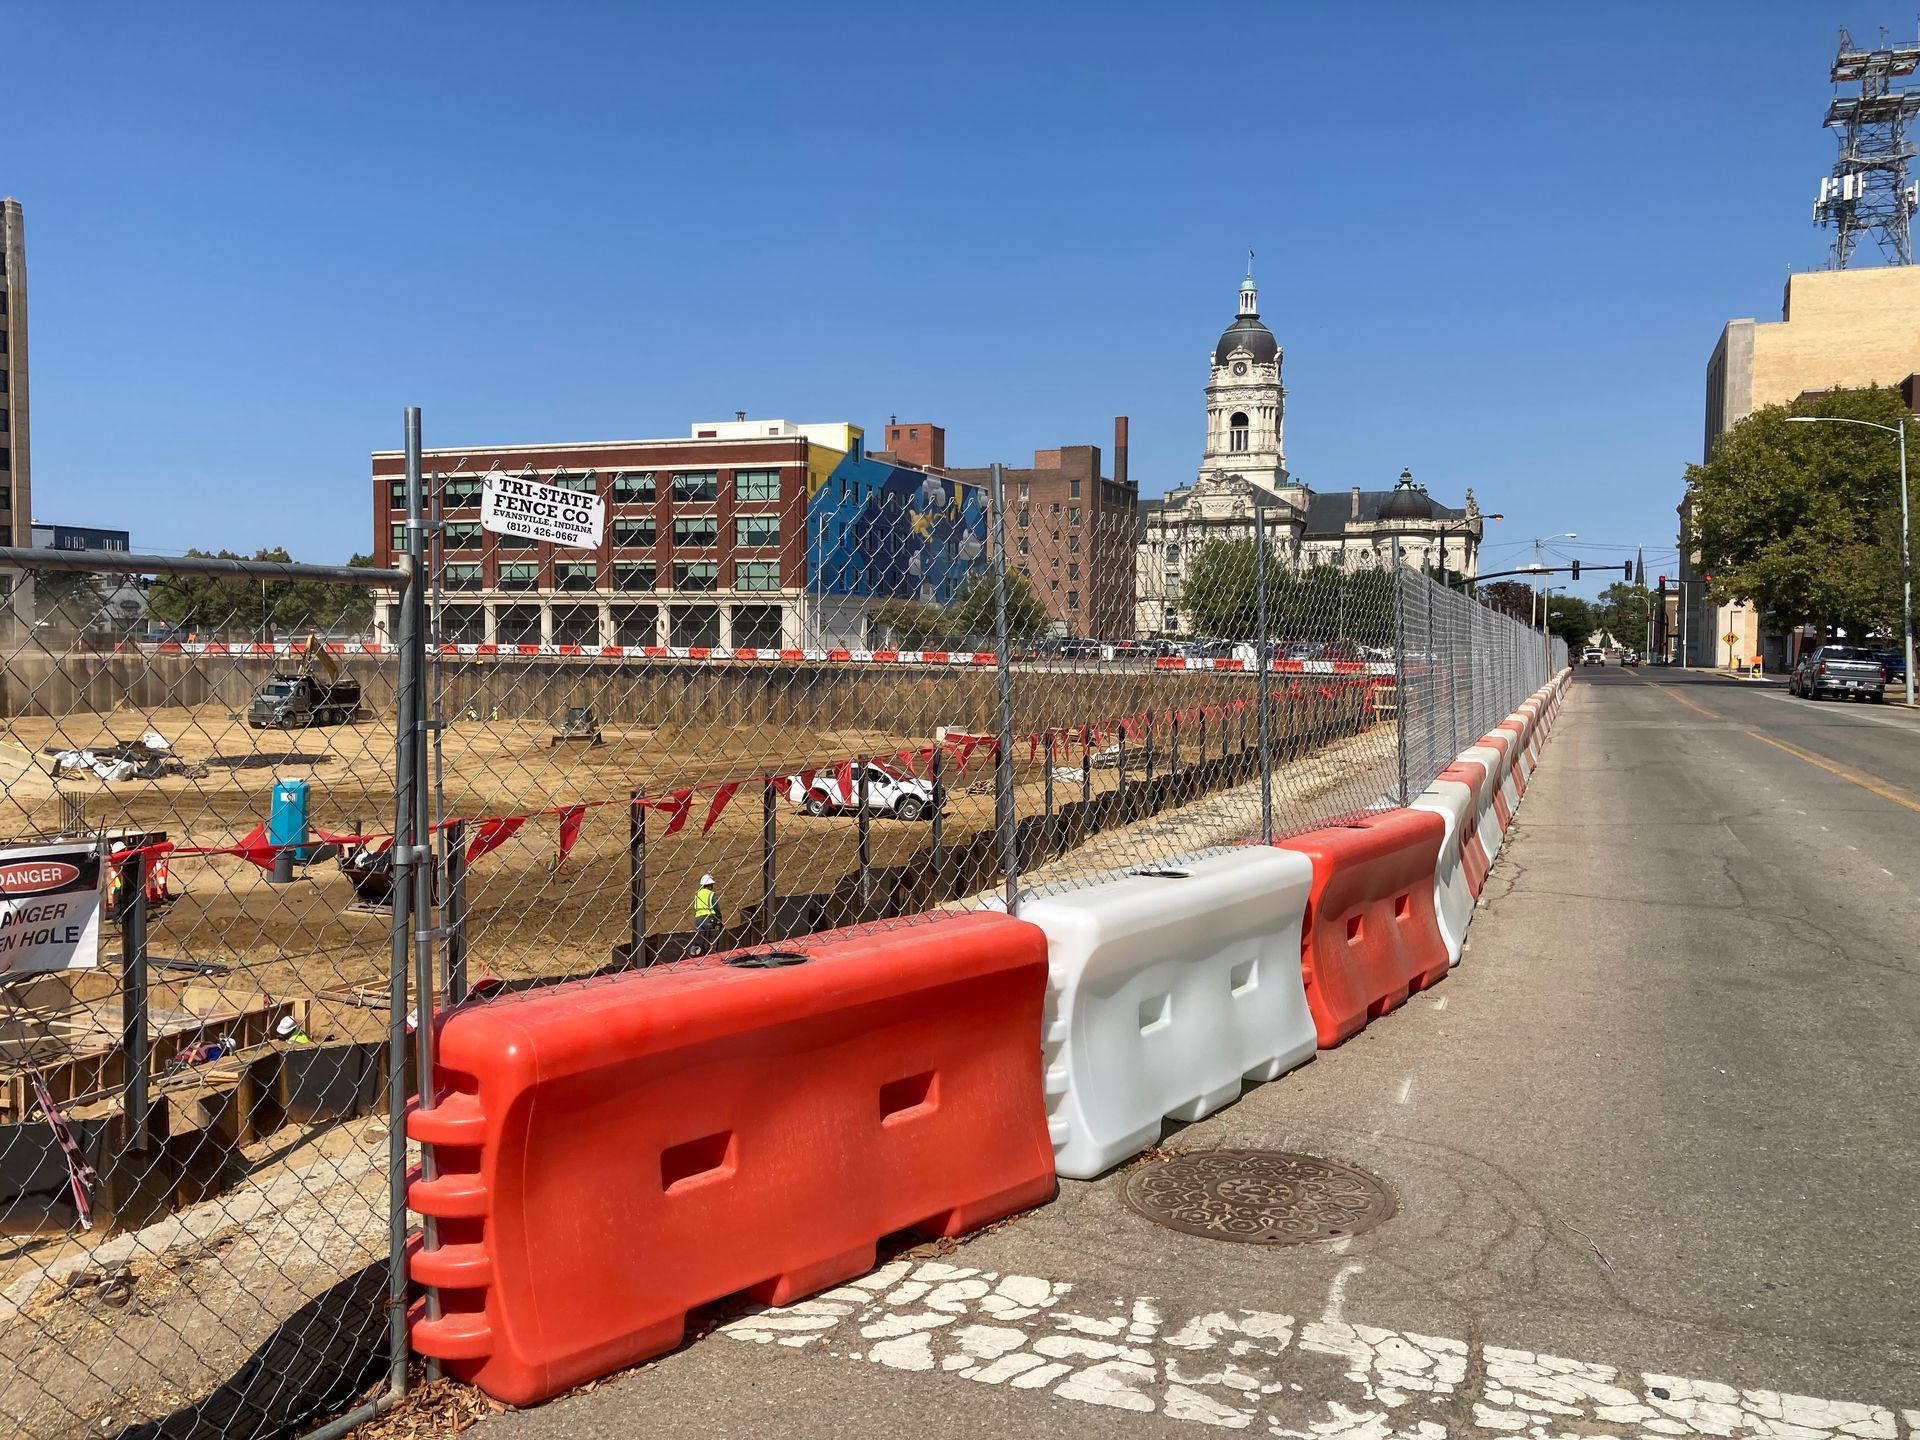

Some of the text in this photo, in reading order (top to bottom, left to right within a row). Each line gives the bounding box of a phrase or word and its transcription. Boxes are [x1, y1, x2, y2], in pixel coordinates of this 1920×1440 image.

[499, 478, 593, 510] TRI-STATE
[493, 493, 593, 526] FENCE CO.
[493, 508, 593, 535] EVANSVILLE, INDIANA
[506, 521, 579, 543] (812) 426-0667
[19, 925, 80, 948] HOLE
